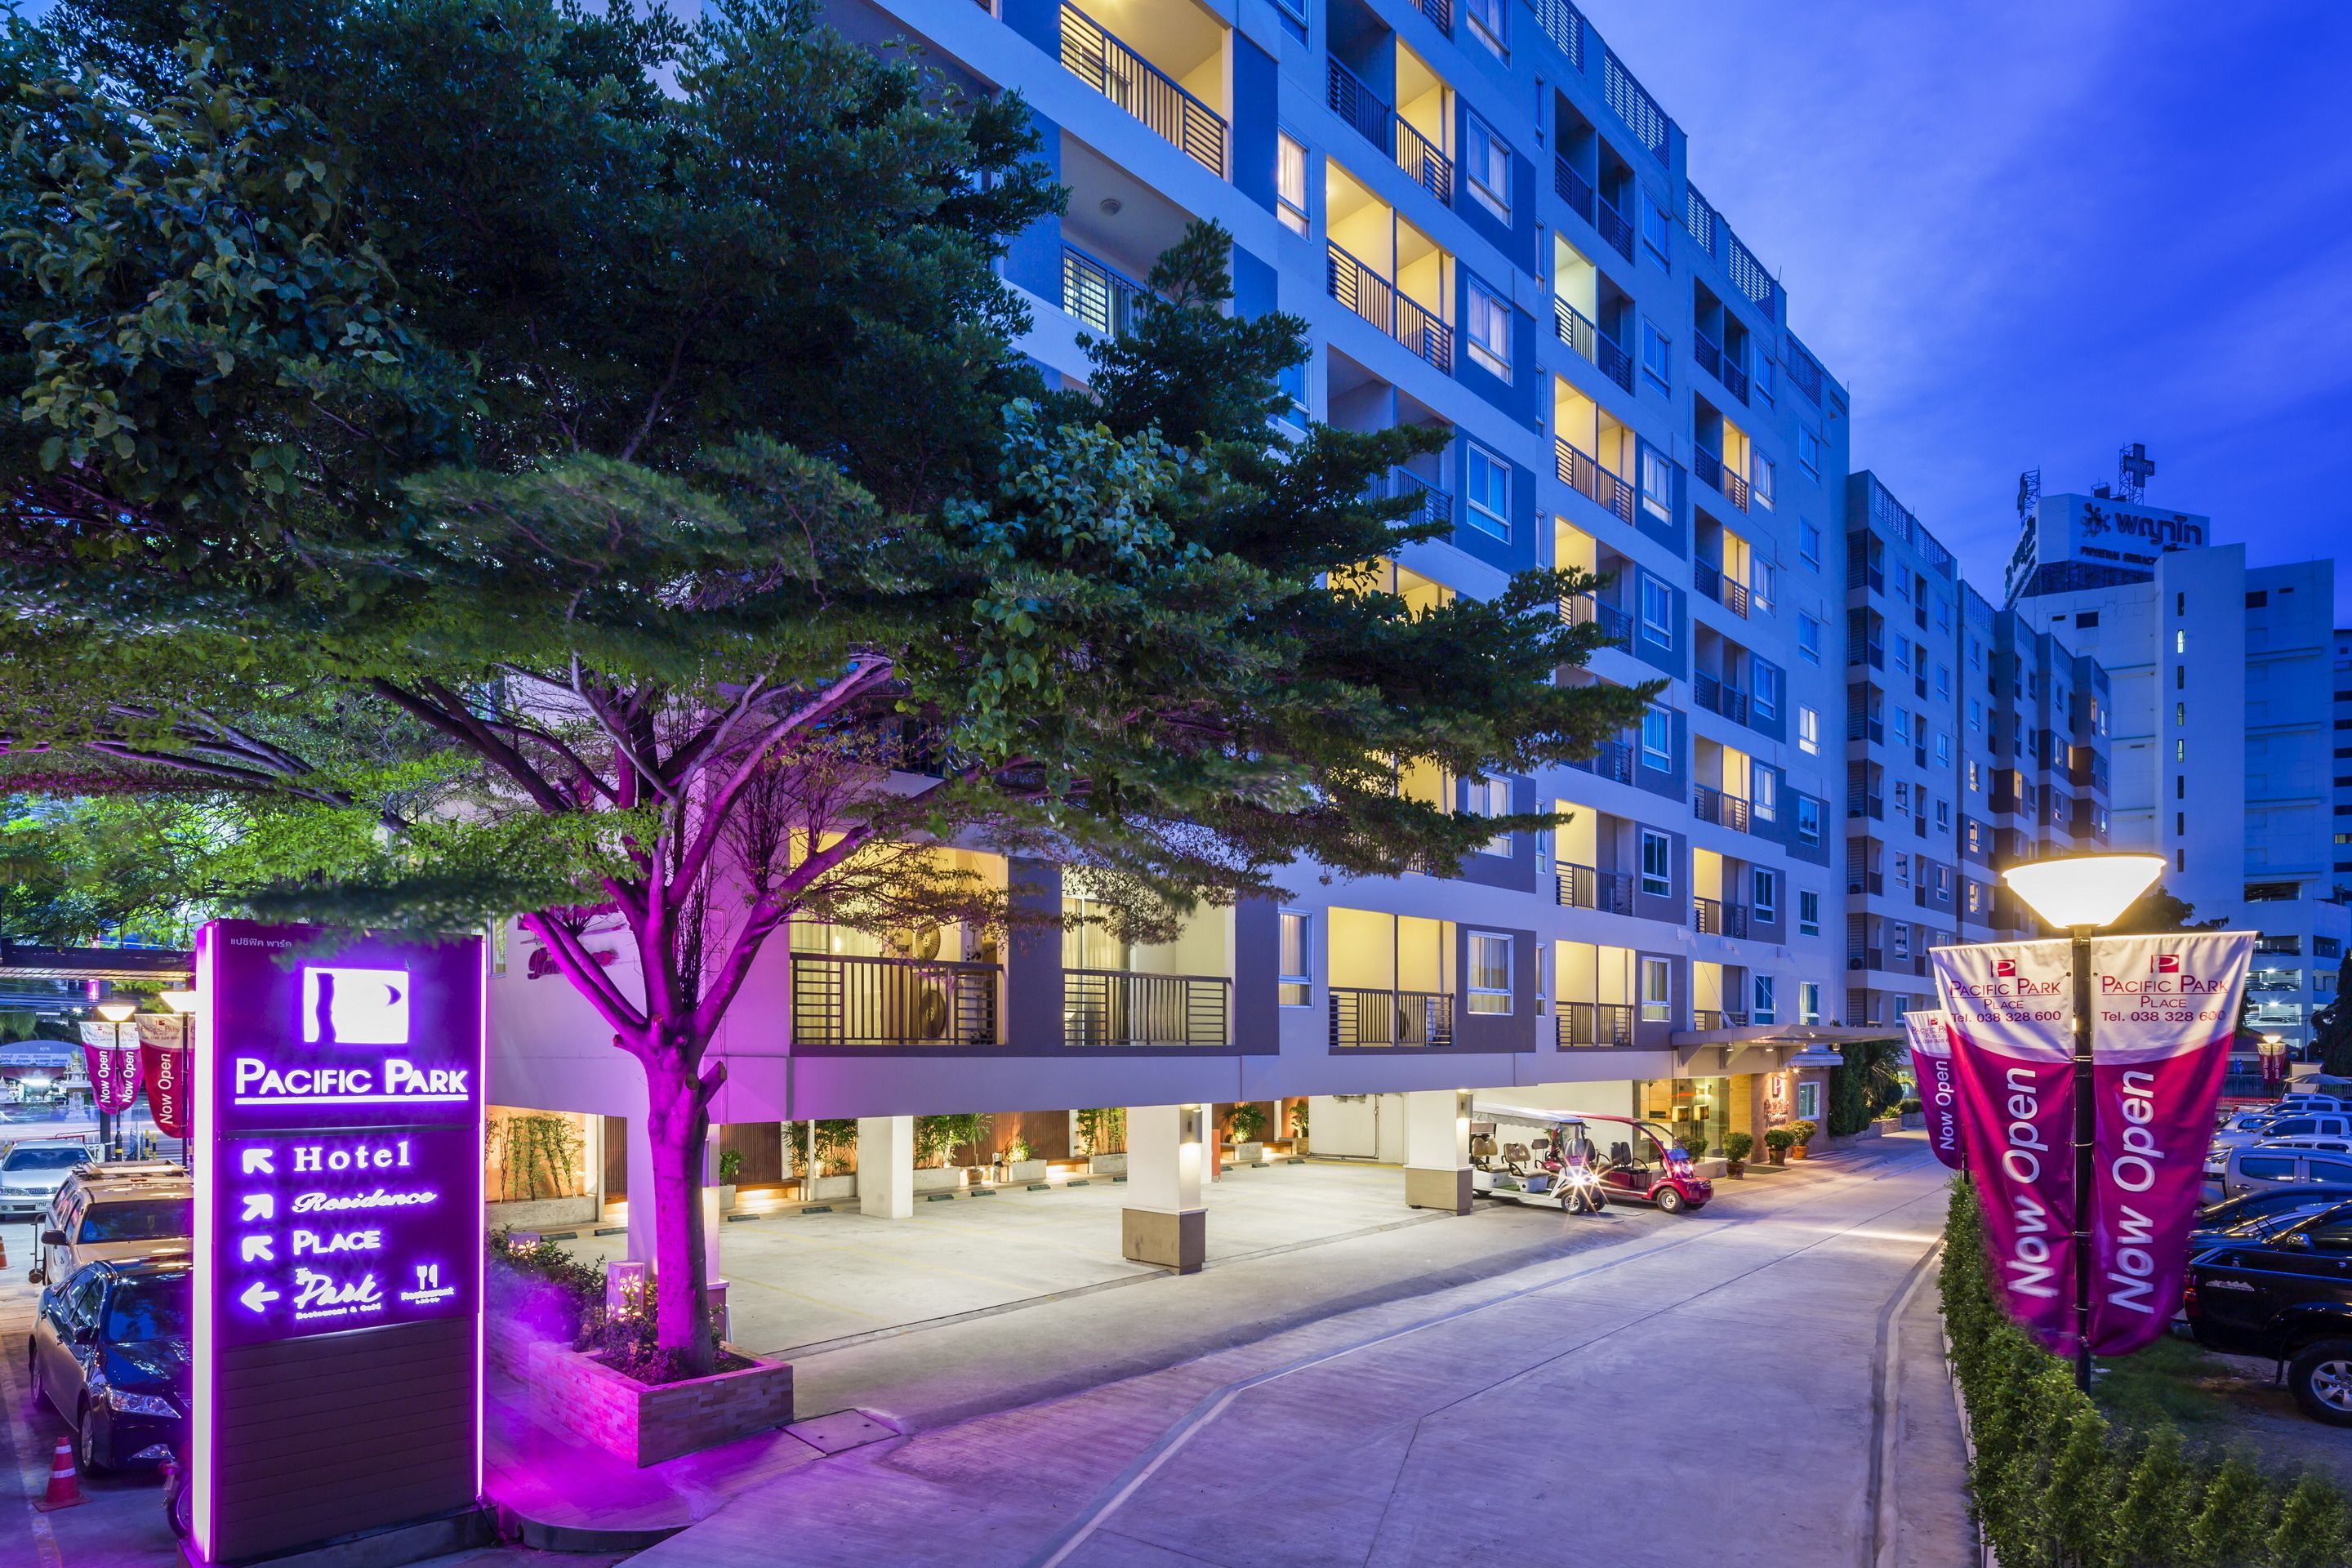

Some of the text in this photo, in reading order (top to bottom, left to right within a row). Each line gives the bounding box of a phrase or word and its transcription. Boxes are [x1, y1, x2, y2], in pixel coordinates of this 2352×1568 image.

[1949, 978, 2061, 996] PACIFIC PARK
[2102, 975, 2229, 992] PACIFIC PARK
[1952, 1010, 2061, 1022] Tel. 038 328 600
[1984, 999, 2024, 1010] PLACE
[2140, 996, 2187, 1008] PLACE
[2101, 1011, 2227, 1022] Tel. 038 328 600
[98, 1050, 111, 1103] Now Open
[123, 1051, 136, 1079] Open
[158, 1054, 174, 1090] Open
[235, 1058, 468, 1094] PACIFIC PARK
[122, 1080, 134, 1103] Now
[158, 1093, 174, 1125] Now
[1935, 1061, 1955, 1151] Now Open
[293, 1141, 410, 1172] Hotel
[2002, 1067, 2060, 1298] Now Open
[2107, 1070, 2165, 1314] Now Open
[292, 1189, 438, 1214] Residence
[293, 1230, 381, 1256] PLACE
[293, 1273, 383, 1310] Park
